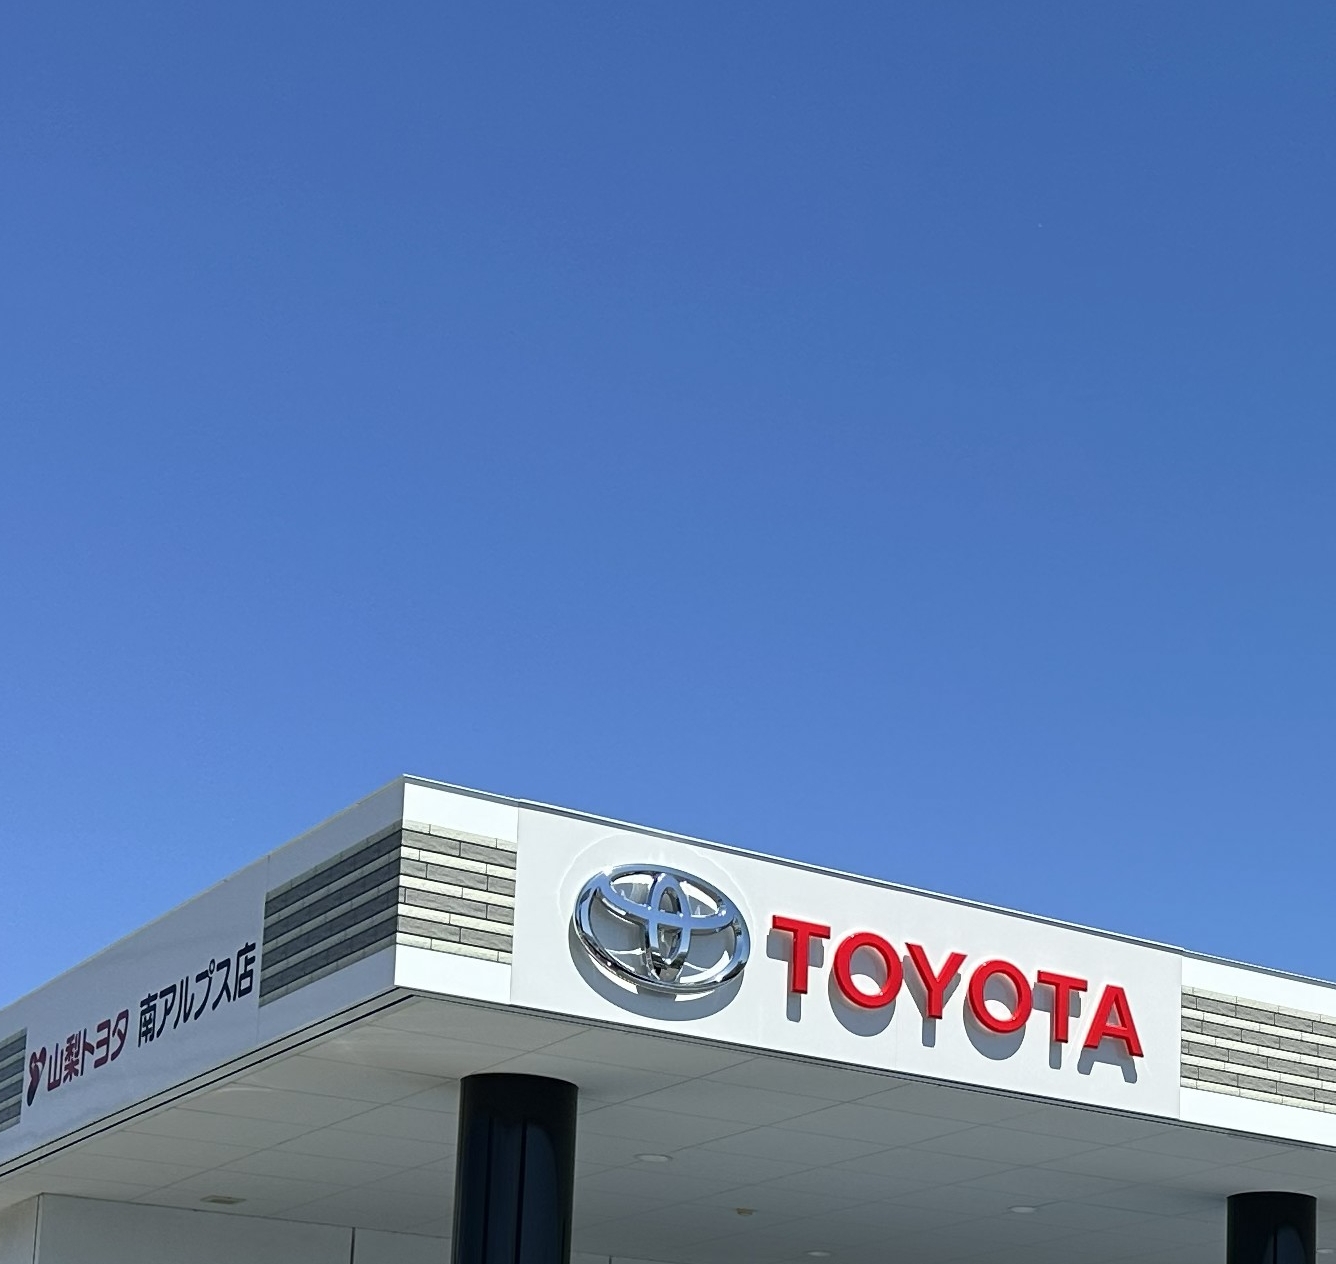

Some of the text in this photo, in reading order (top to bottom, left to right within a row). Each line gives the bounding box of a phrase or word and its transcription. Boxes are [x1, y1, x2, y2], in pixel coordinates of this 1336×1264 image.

[47, 942, 256, 1092] 山梨トヨタ 南アルプス店
[772, 914, 1144, 1058] TOYOTA
